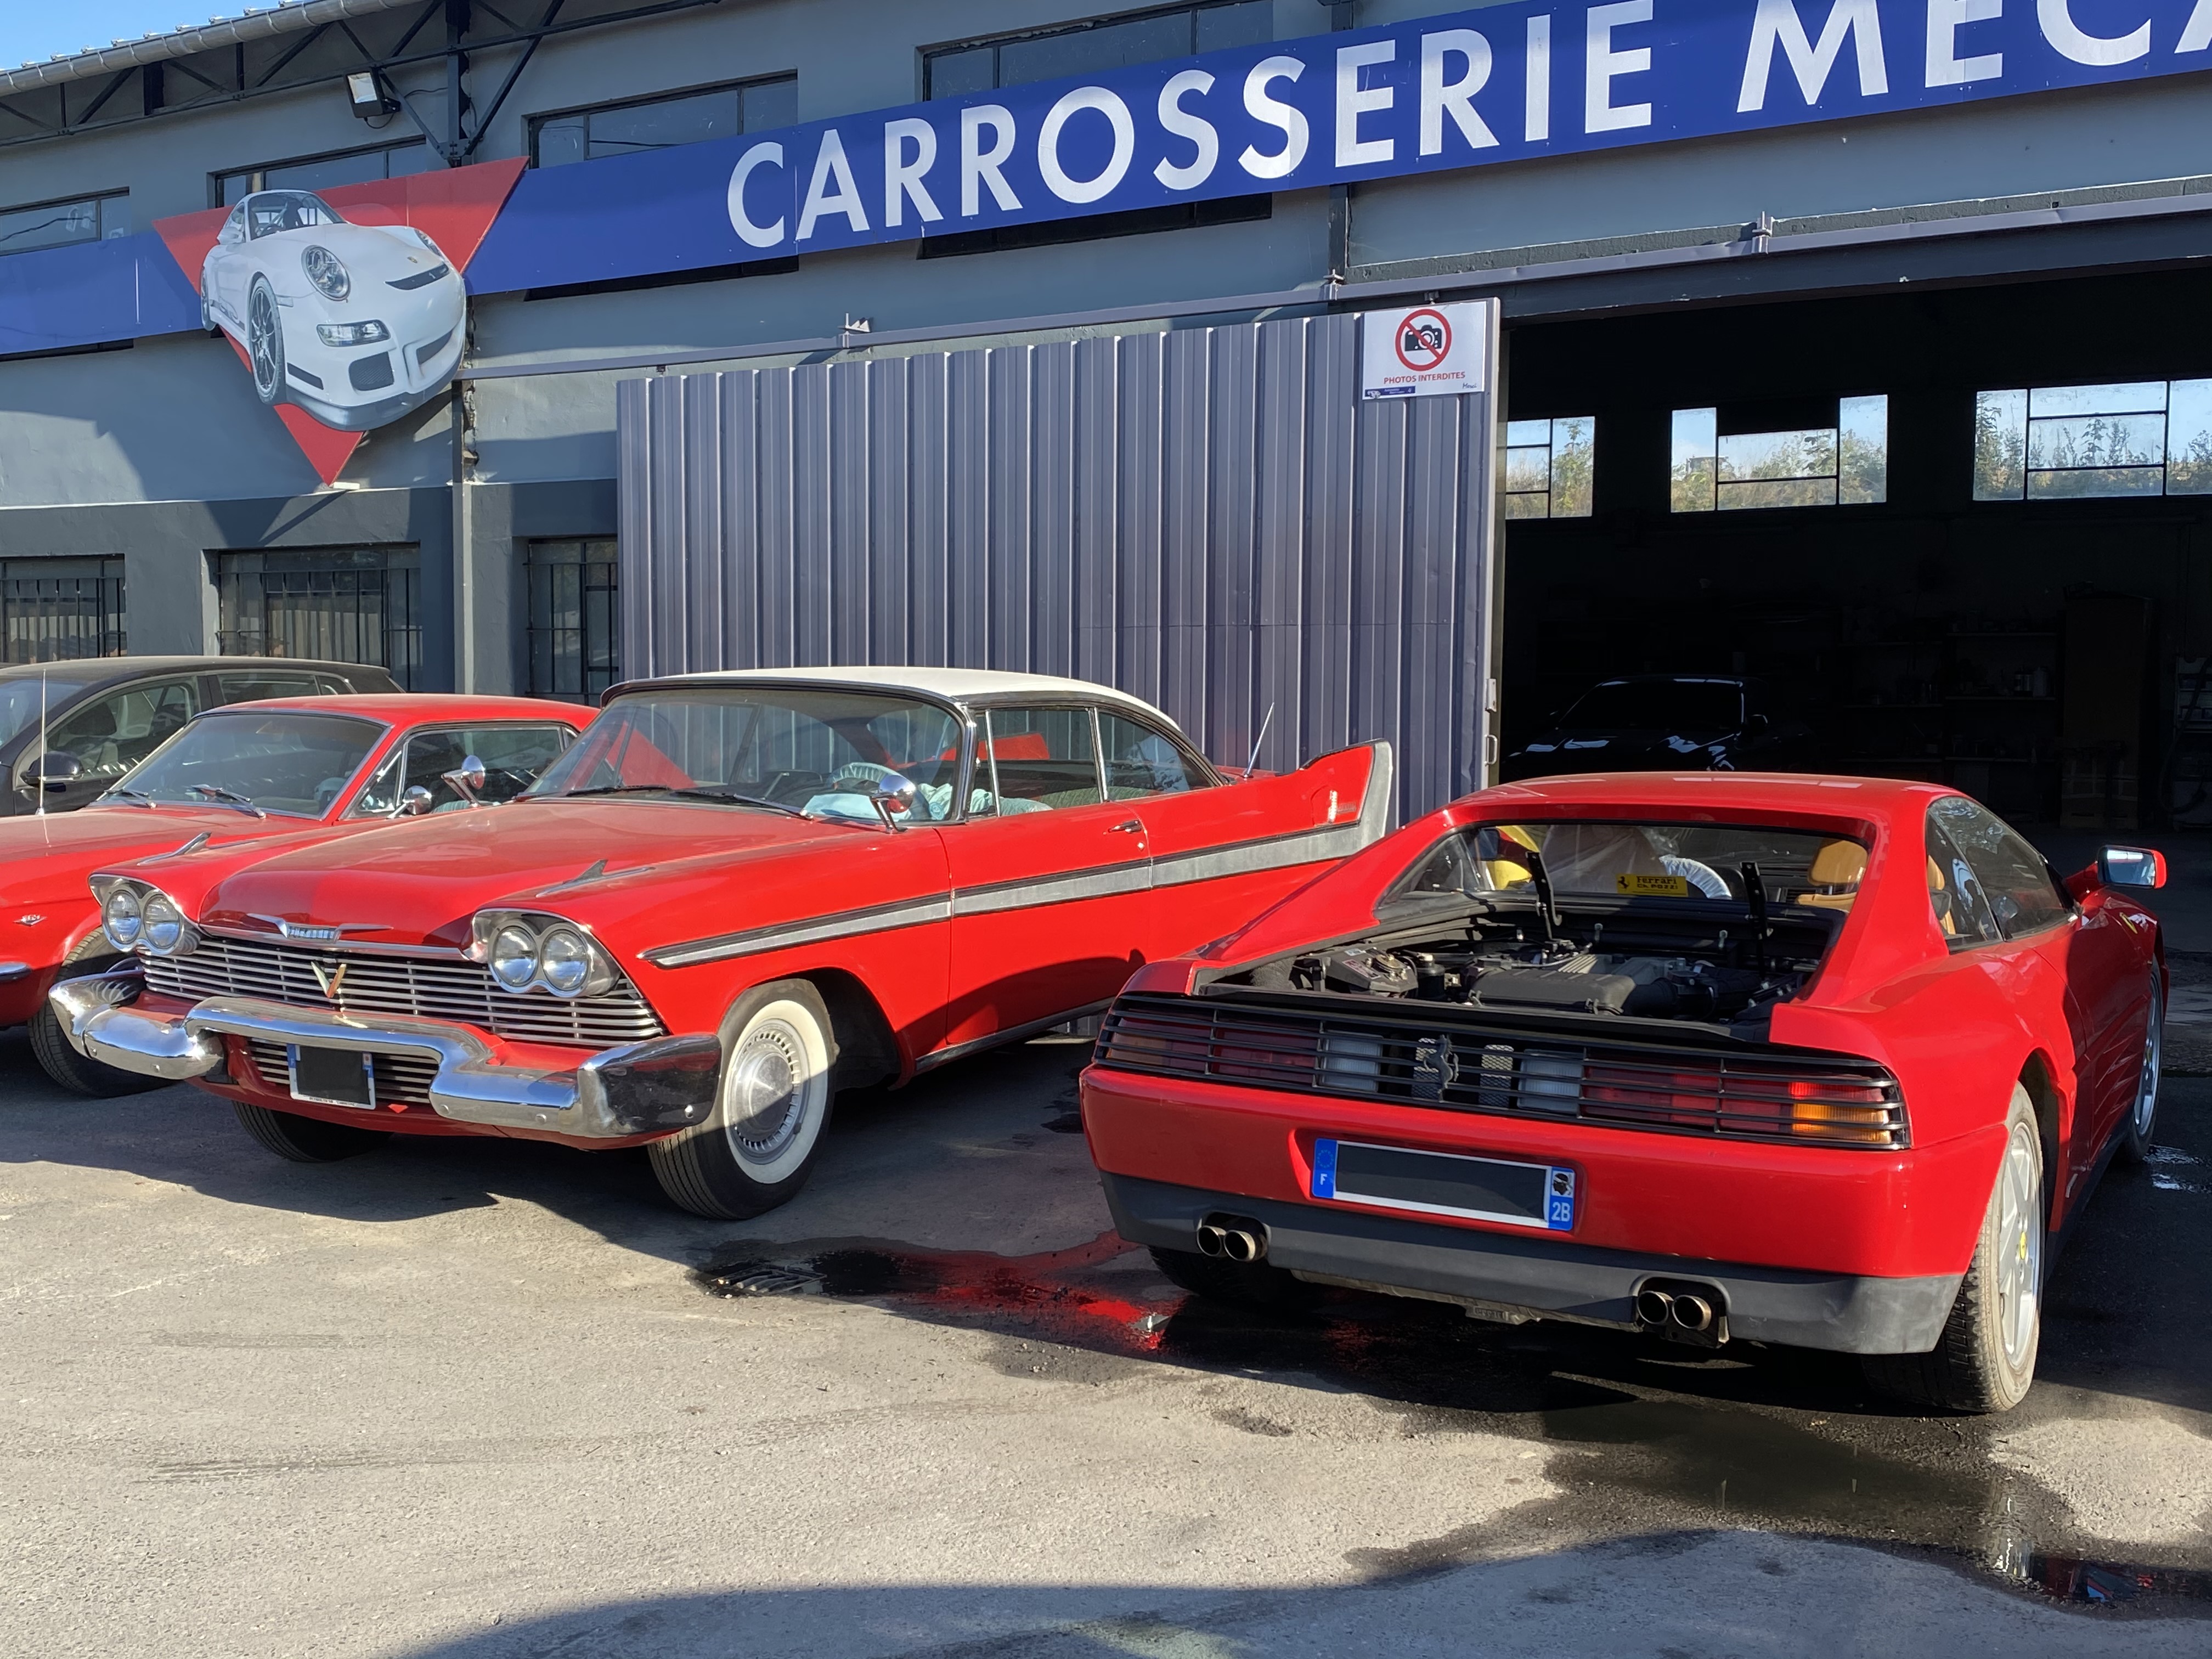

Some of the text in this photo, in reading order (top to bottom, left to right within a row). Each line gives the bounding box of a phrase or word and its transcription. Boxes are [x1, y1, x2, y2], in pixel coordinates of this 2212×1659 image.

[727, 0, 1653, 248] CARROSSERIE
[1384, 371, 1465, 384] PHOTOS INTERDITES
[1319, 1173, 1328, 1186] F
[1551, 1201, 1571, 1223] 2B
